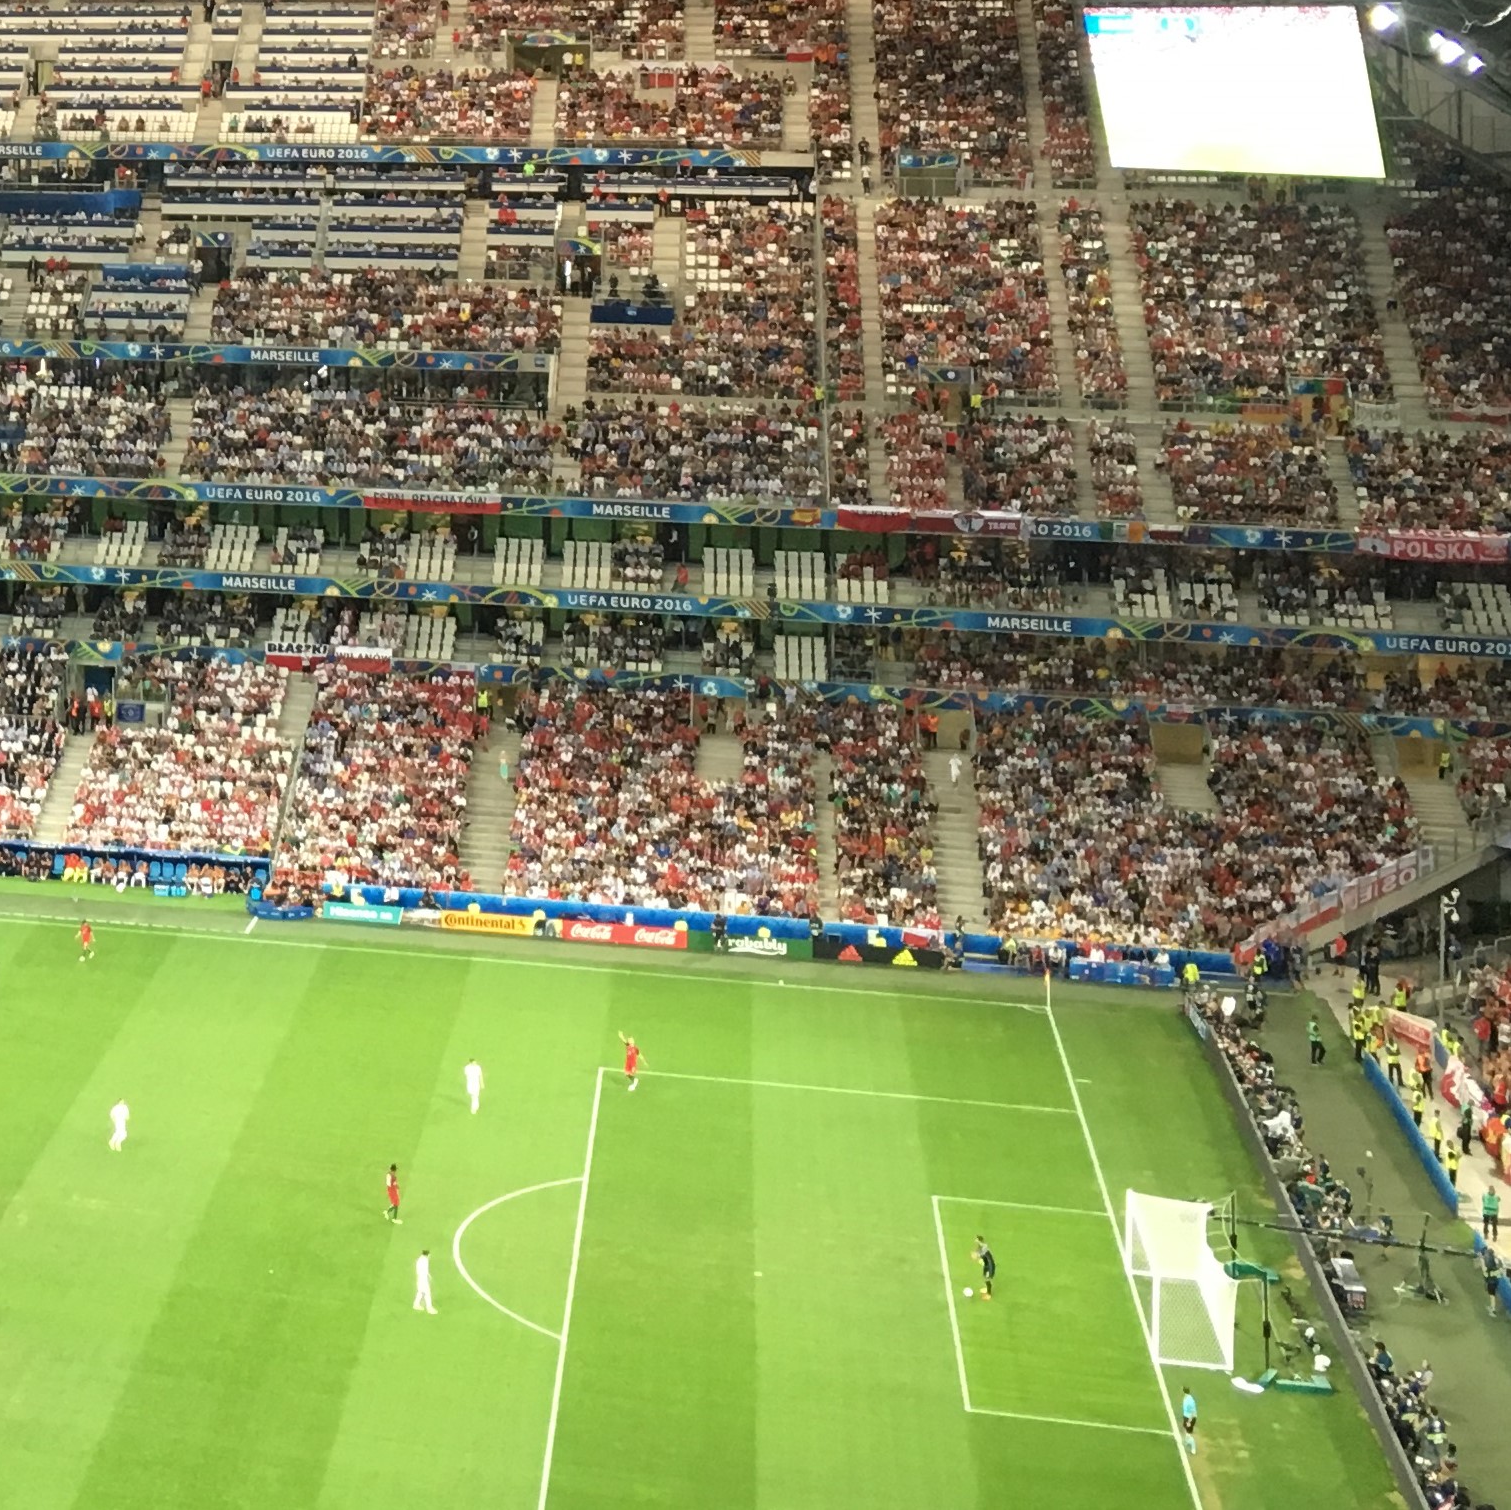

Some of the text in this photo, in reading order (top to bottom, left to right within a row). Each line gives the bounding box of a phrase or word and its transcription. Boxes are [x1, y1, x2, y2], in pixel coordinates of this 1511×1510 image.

[266, 148, 369, 159] UEFA EURO 2016
[250, 350, 319, 362] MARSEILLE
[206, 487, 321, 503] UEFA EURO 2016
[592, 503, 671, 518] MARSEILLE
[1052, 524, 1092, 538] 2016
[1392, 539, 1476, 560] POLSKA
[221, 575, 296, 591] MARSEILLE
[567, 593, 692, 612] UEFA EURO 2016
[987, 616, 1072, 633] MARSEILLE
[1386, 636, 1431, 651] UEFA
[1434, 639, 1482, 653] EURO
[444, 913, 515, 930] Continental
[727, 936, 788, 956] robably
